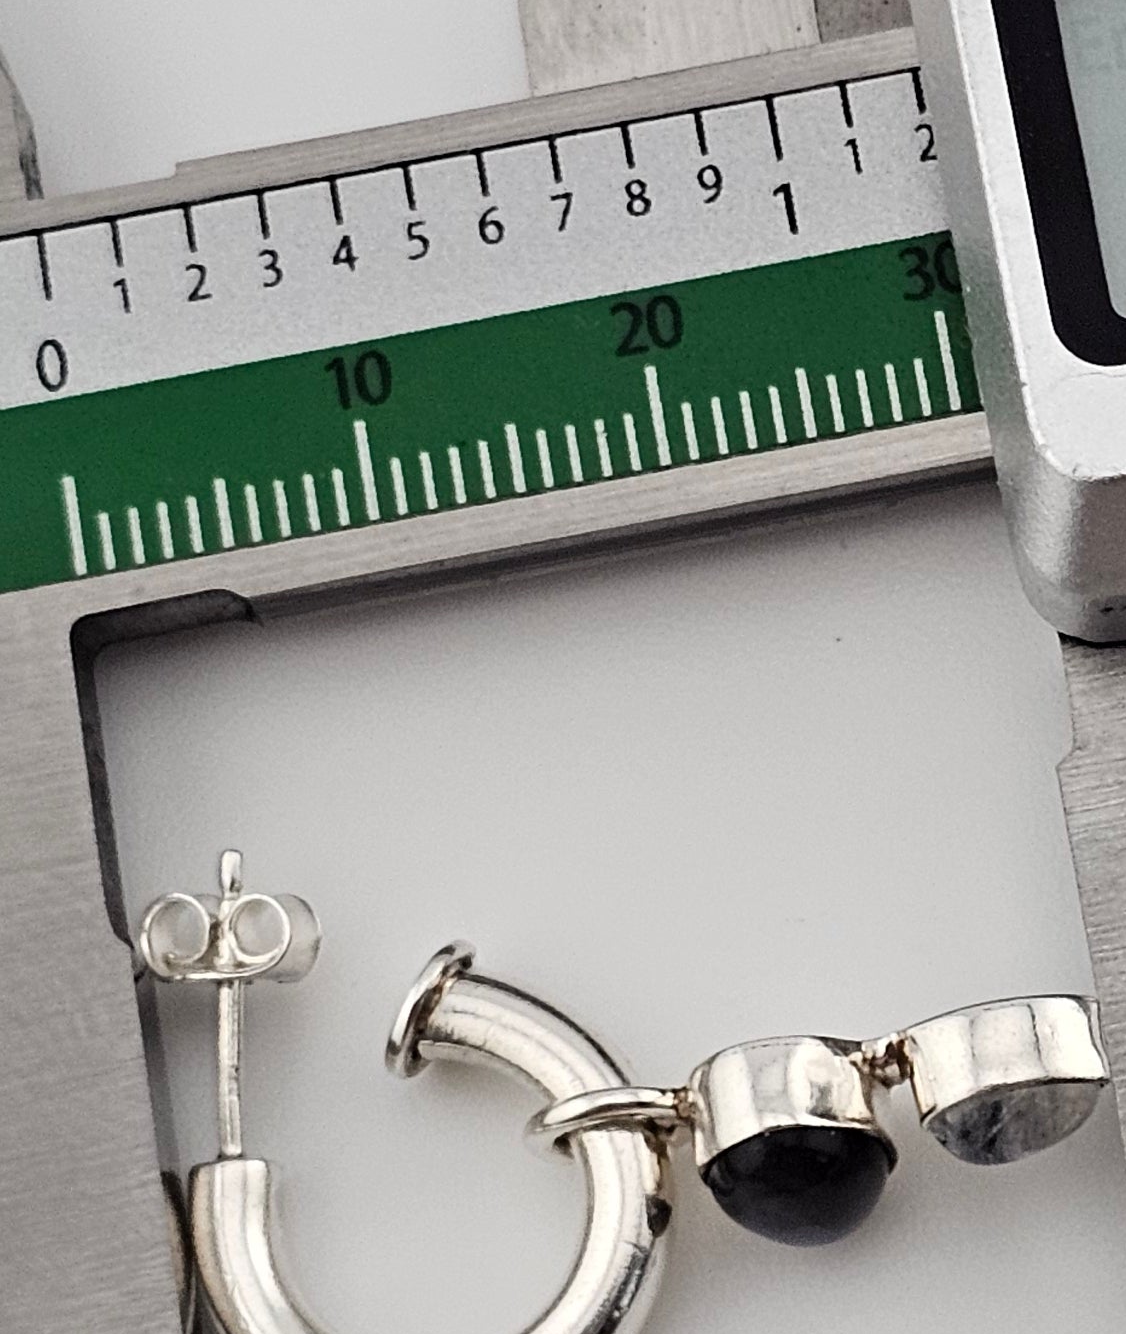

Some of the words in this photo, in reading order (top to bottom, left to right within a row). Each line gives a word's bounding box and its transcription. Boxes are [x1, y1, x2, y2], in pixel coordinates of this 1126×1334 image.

[35, 339, 69, 392] 0
[113, 278, 130, 313] 1
[185, 263, 212, 302] 2
[258, 249, 283, 288] 3
[332, 235, 358, 271] 4
[406, 220, 430, 261] 5
[478, 206, 505, 245] 6
[550, 192, 573, 232] 7
[624, 178, 652, 217] 8
[696, 164, 723, 204] 9
[772, 182, 799, 235] 1
[844, 137, 863, 175] 1
[914, 123, 938, 163] 2
[323, 349, 393, 411] 10
[609, 294, 684, 358] 20
